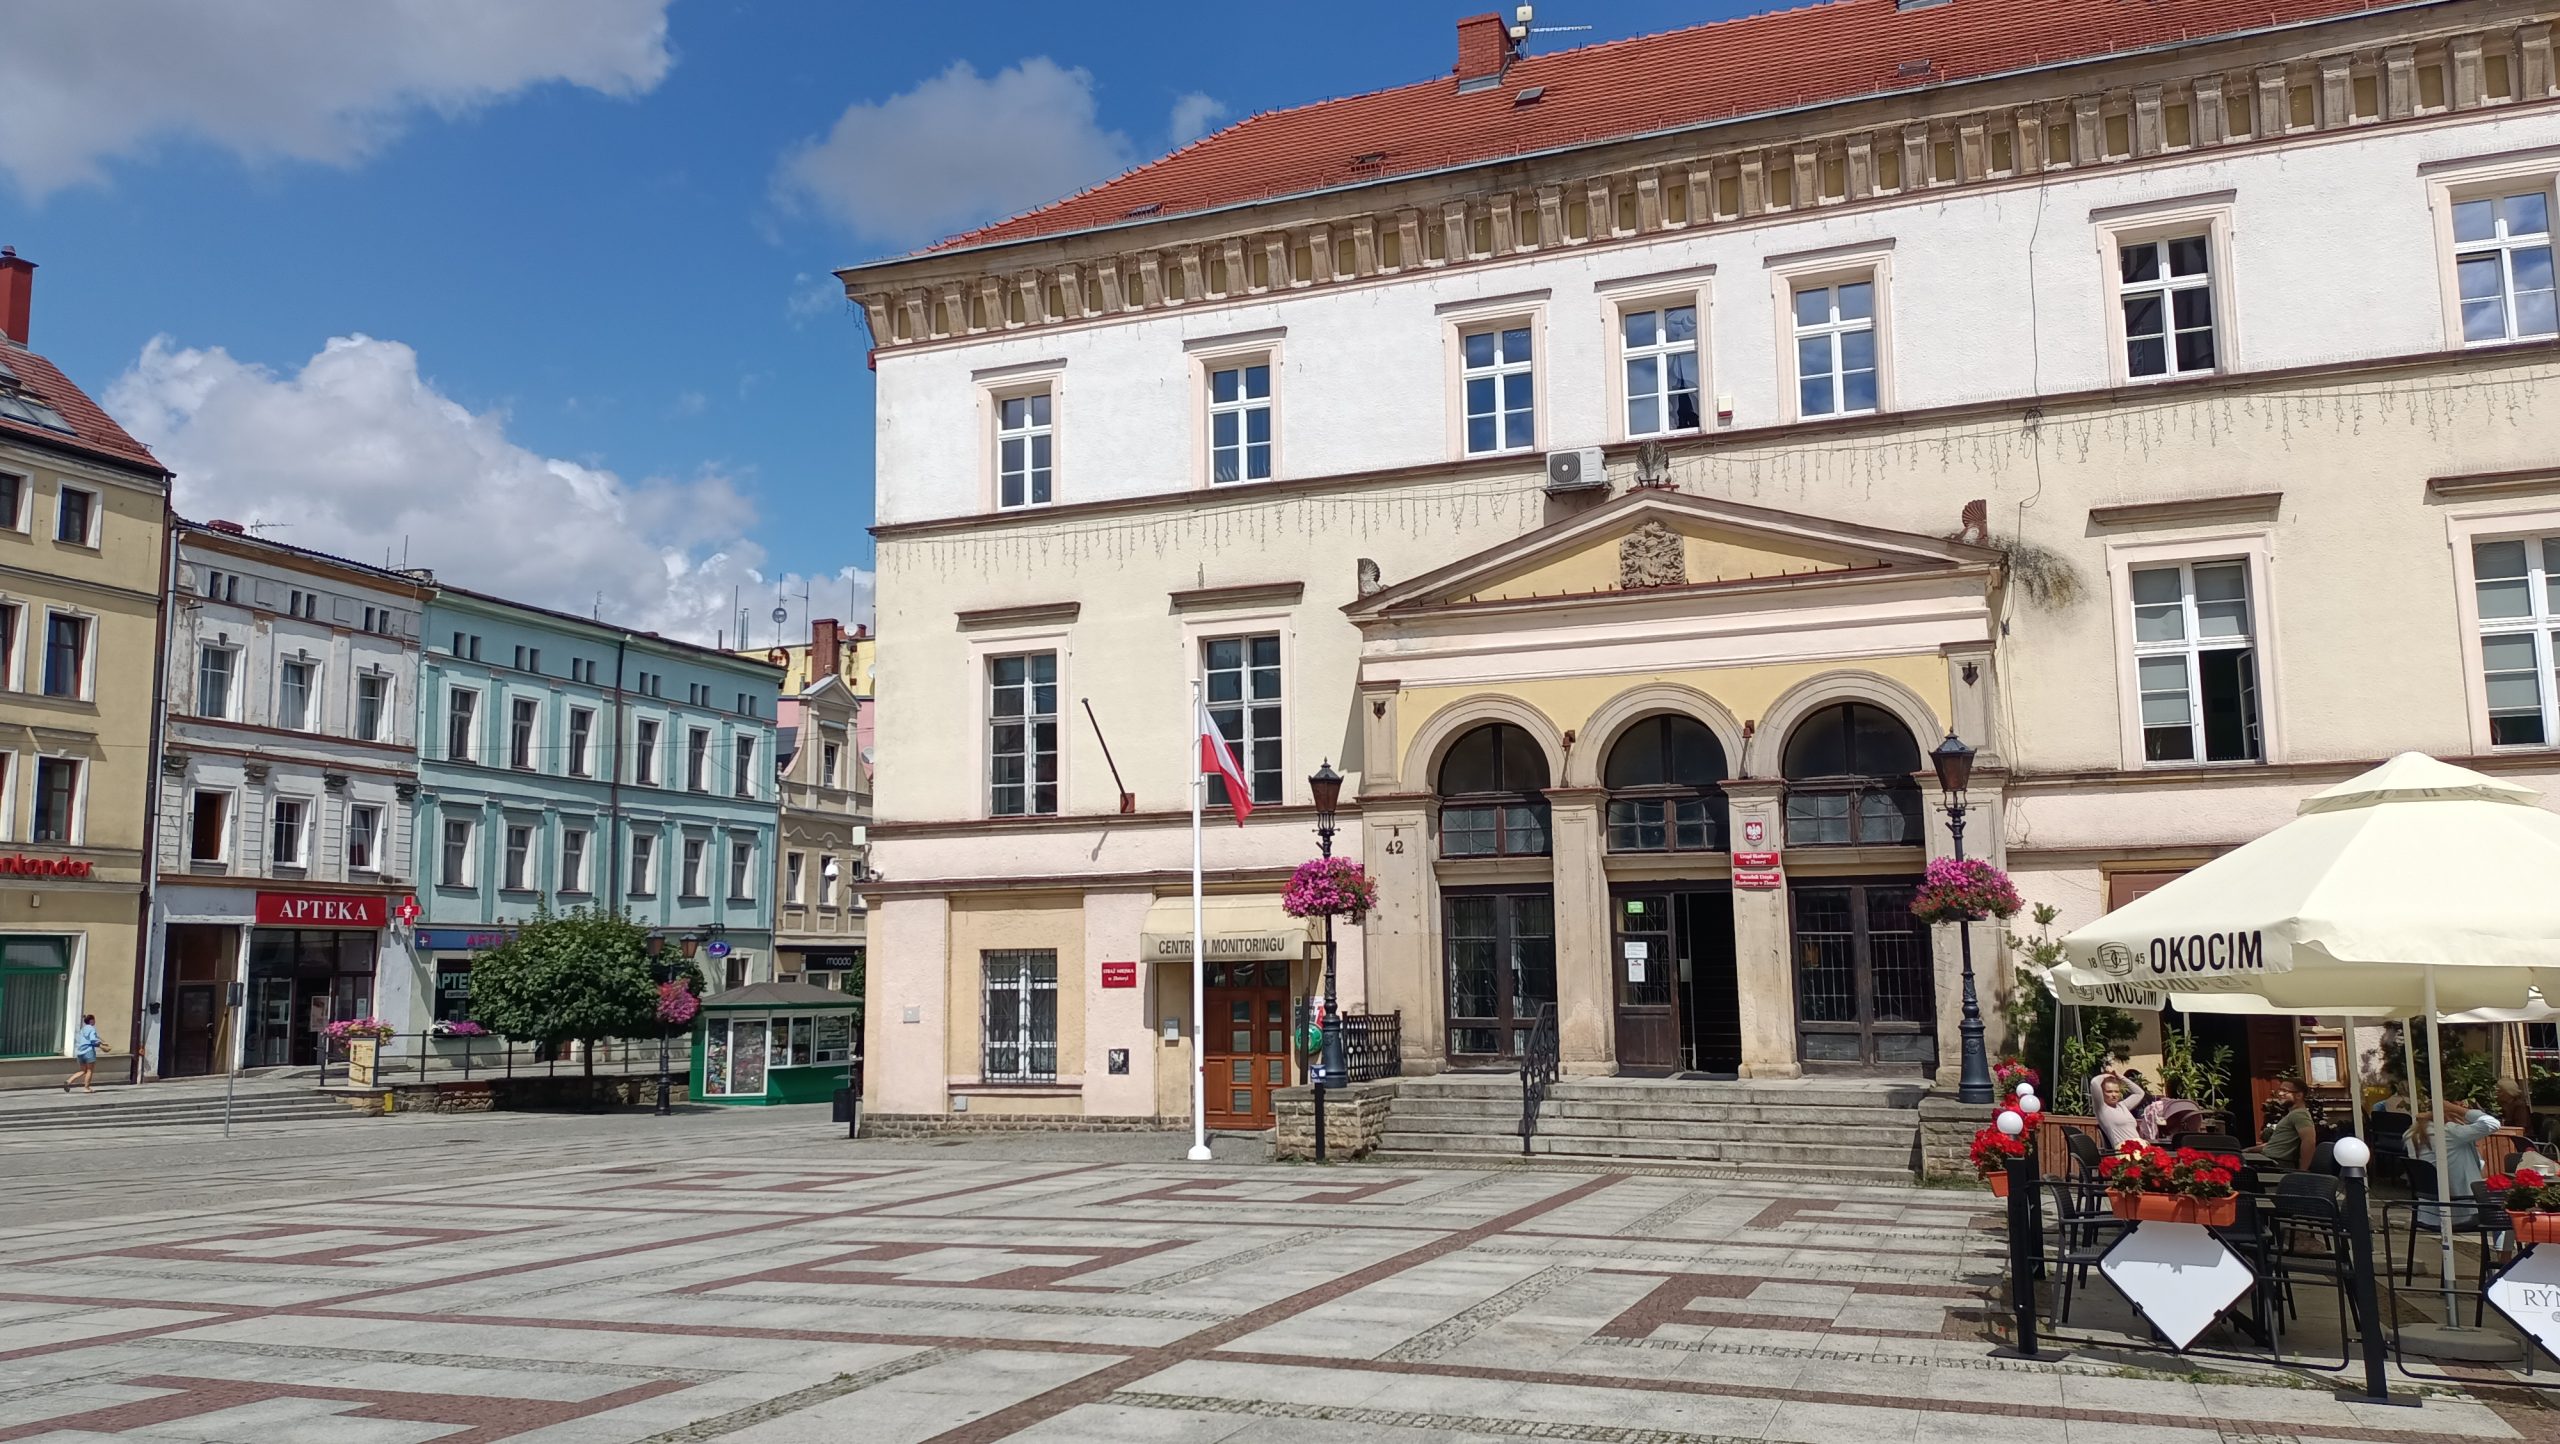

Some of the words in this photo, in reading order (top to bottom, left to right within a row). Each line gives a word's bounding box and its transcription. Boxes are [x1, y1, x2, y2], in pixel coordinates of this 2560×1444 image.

[1385, 840, 1404, 855] 42
[0, 853, 94, 877] ntander
[279, 899, 368, 920] APTEKA
[1211, 938, 1285, 953] MONITORINGU
[2087, 957, 2098, 969] 18
[2134, 952, 2145, 965] 45
[2150, 930, 2263, 974] OKOCIM
[436, 972, 471, 989] APTE
[2103, 981, 2157, 1006] OKOCIM
